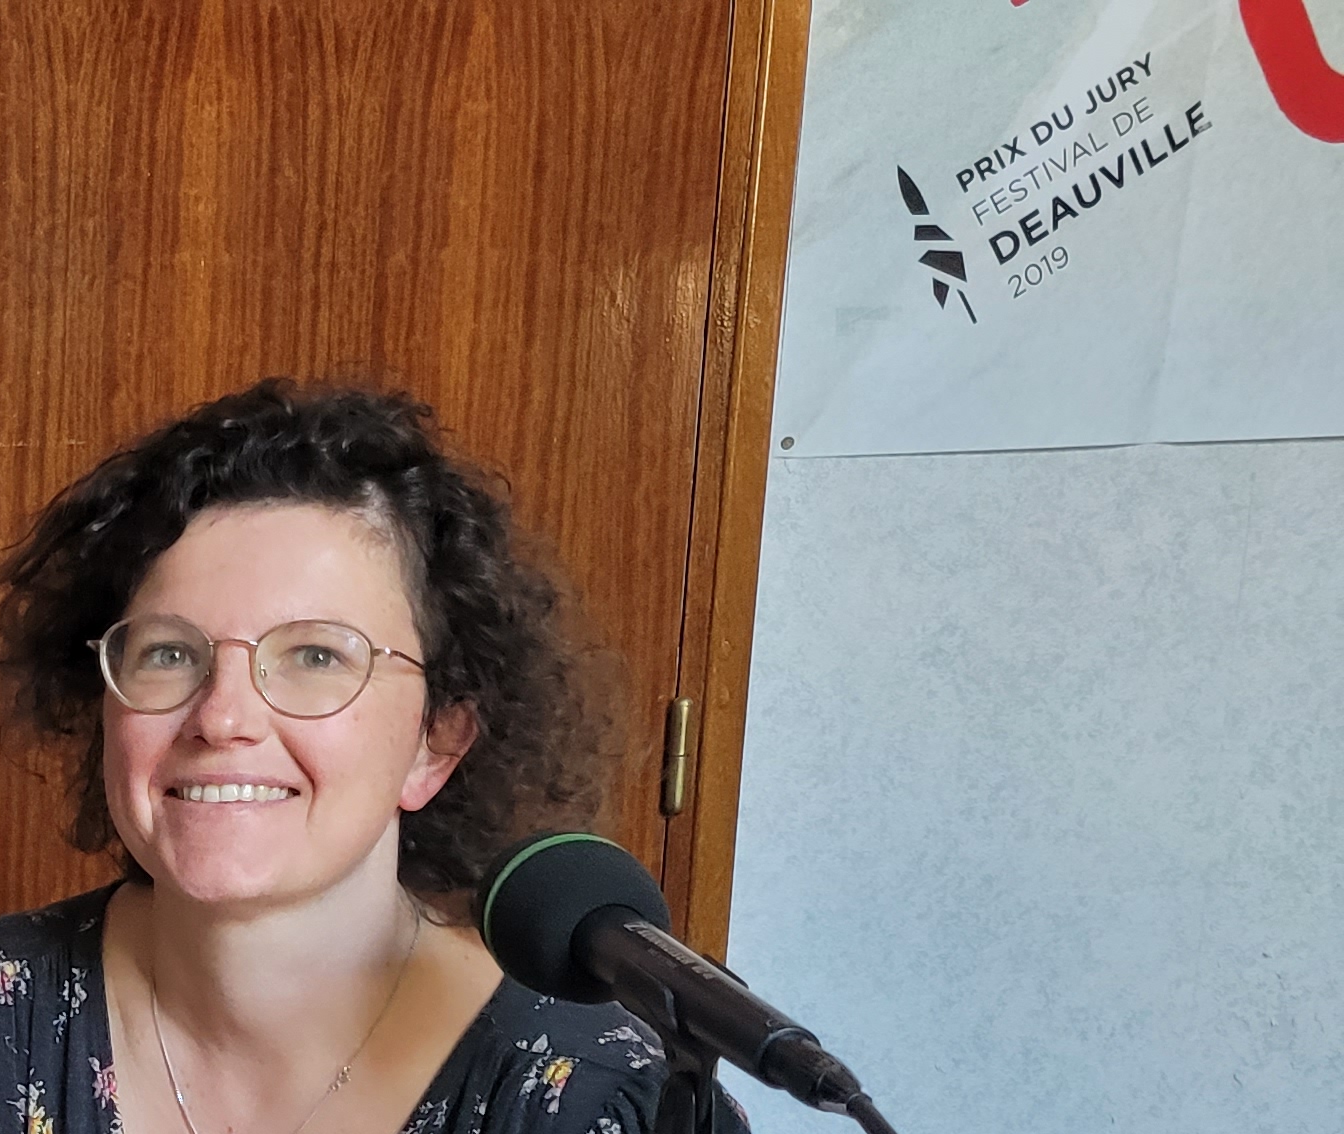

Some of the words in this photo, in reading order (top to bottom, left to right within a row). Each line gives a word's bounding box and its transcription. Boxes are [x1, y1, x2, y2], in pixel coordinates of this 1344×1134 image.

[955, 135, 1028, 194] PRIX
[1029, 104, 1074, 147] DU
[1085, 51, 1152, 115] JURY
[970, 131, 1109, 227] FESTIVAL
[1111, 96, 1155, 138] DE
[987, 100, 1214, 266] DEAUVILLE
[1007, 245, 1070, 300] 2019
